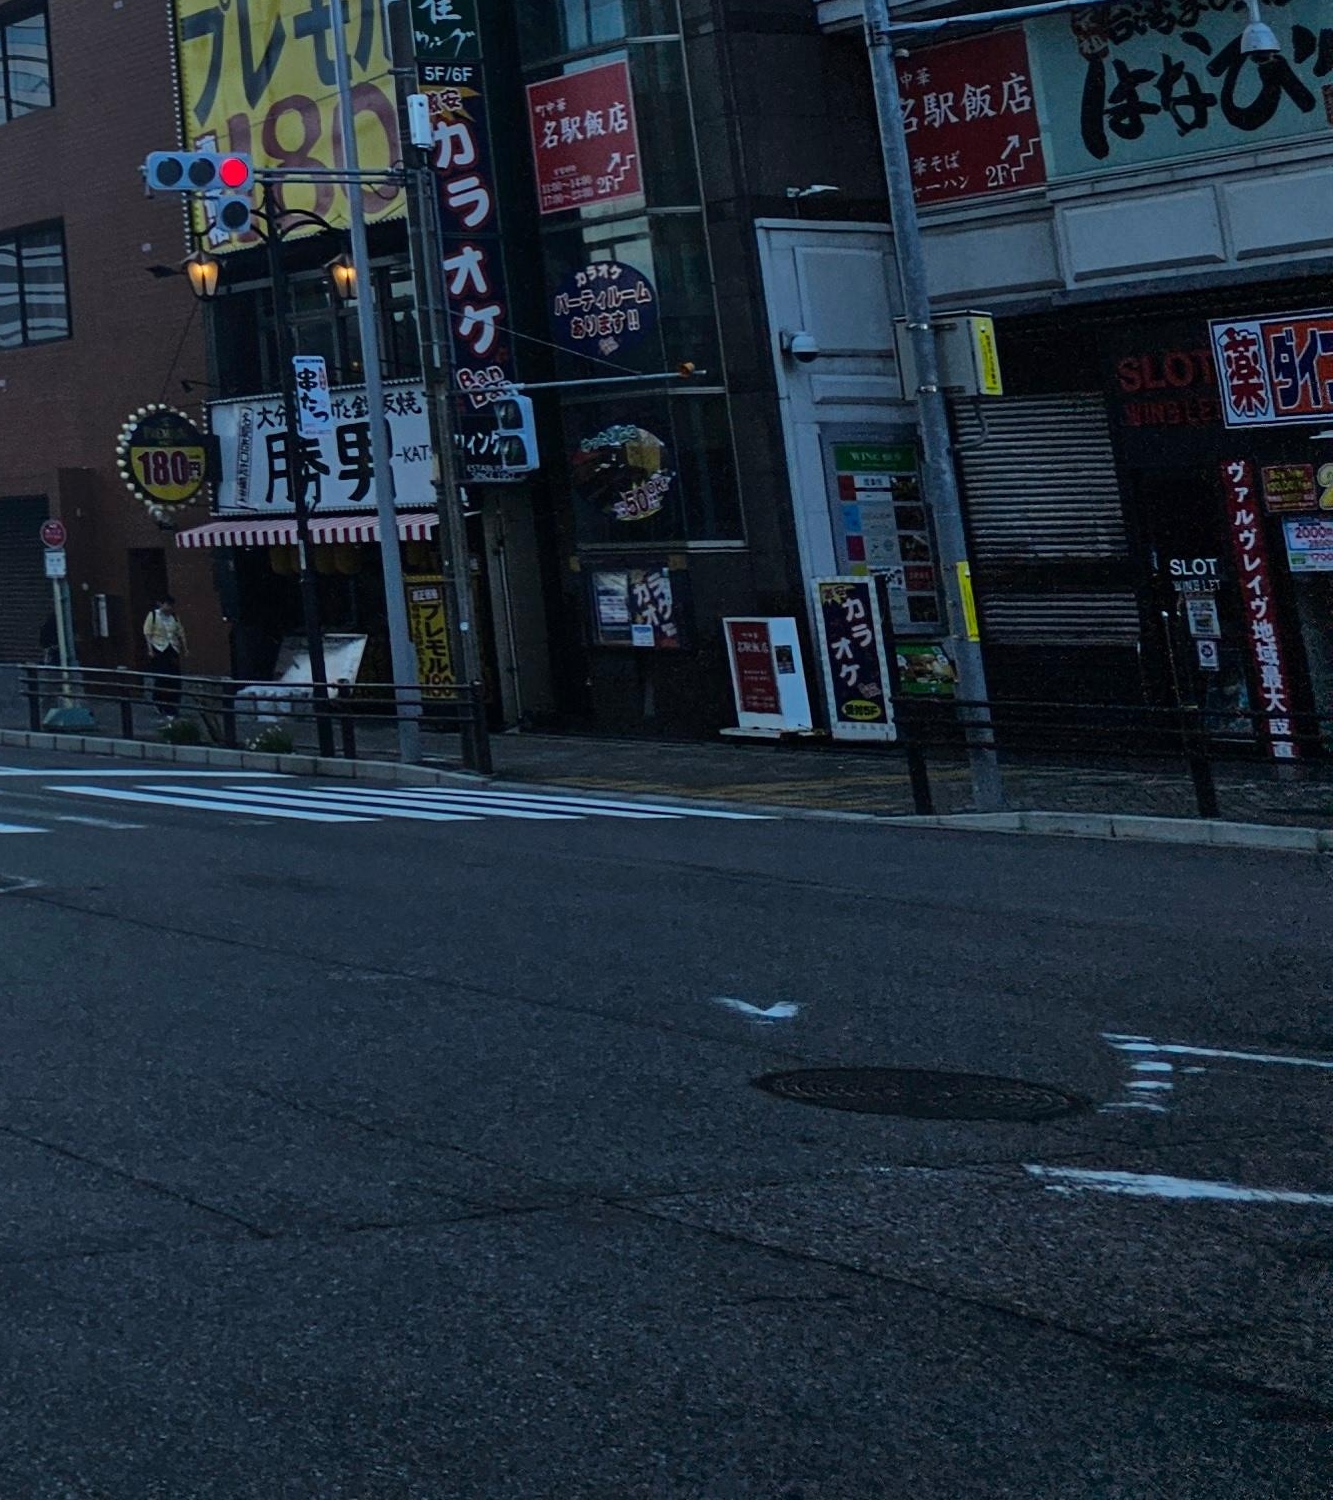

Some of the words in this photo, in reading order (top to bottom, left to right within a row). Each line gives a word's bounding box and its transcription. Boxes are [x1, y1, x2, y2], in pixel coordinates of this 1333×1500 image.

[424, 66, 473, 82] 5F/6F
[900, 67, 932, 90] 中華
[540, 102, 629, 149] 名駅飯店
[913, 150, 960, 176] 華そば
[986, 164, 1010, 187] 2F
[596, 174, 615, 194] 2F
[436, 121, 502, 353] カラオケ
[575, 264, 623, 288] カラオケ
[554, 281, 652, 316] パーティルーム
[1117, 350, 1218, 393] SLOT
[1218, 327, 1268, 417] 薬
[138, 451, 201, 486] 180円
[266, 422, 396, 507] 勝男
[1169, 558, 1218, 576] SLOT
[831, 598, 873, 687] カラオケ
